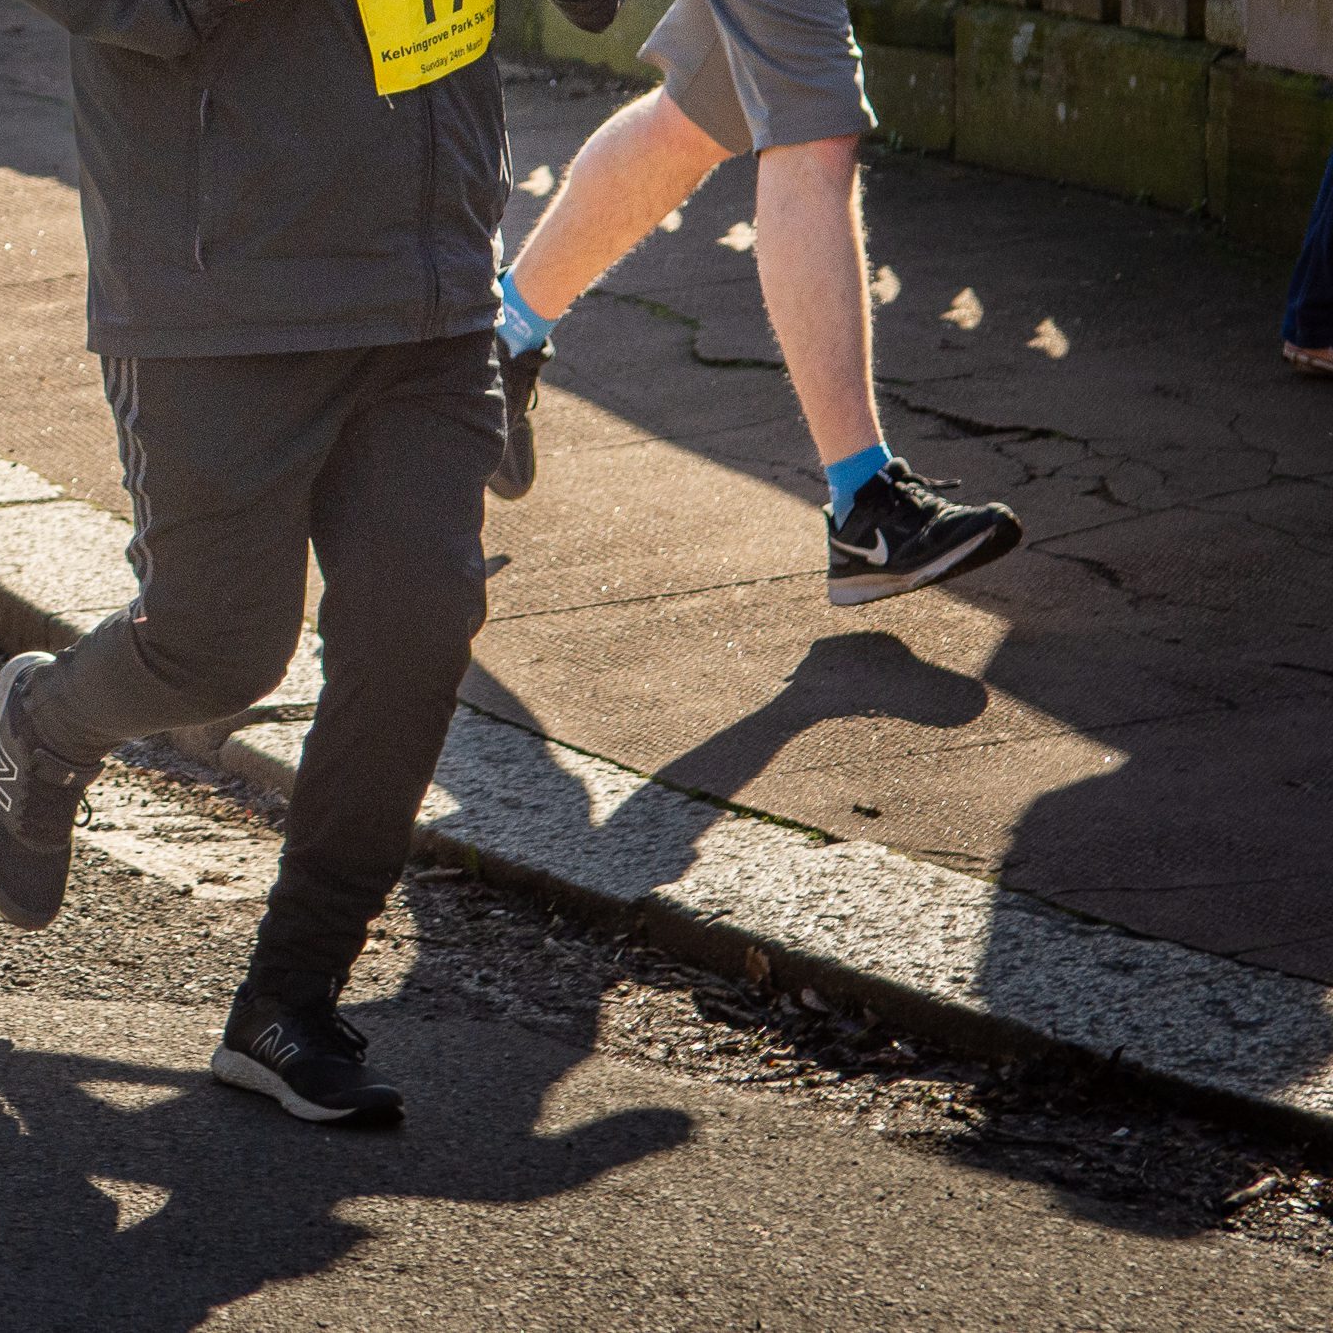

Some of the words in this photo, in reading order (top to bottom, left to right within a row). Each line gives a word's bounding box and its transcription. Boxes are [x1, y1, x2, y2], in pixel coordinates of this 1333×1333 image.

[381, 30, 449, 63] Kelvingrove
[451, 17, 473, 36] Park
[420, 56, 448, 74] Sunday
[449, 47, 465, 62] 24th
